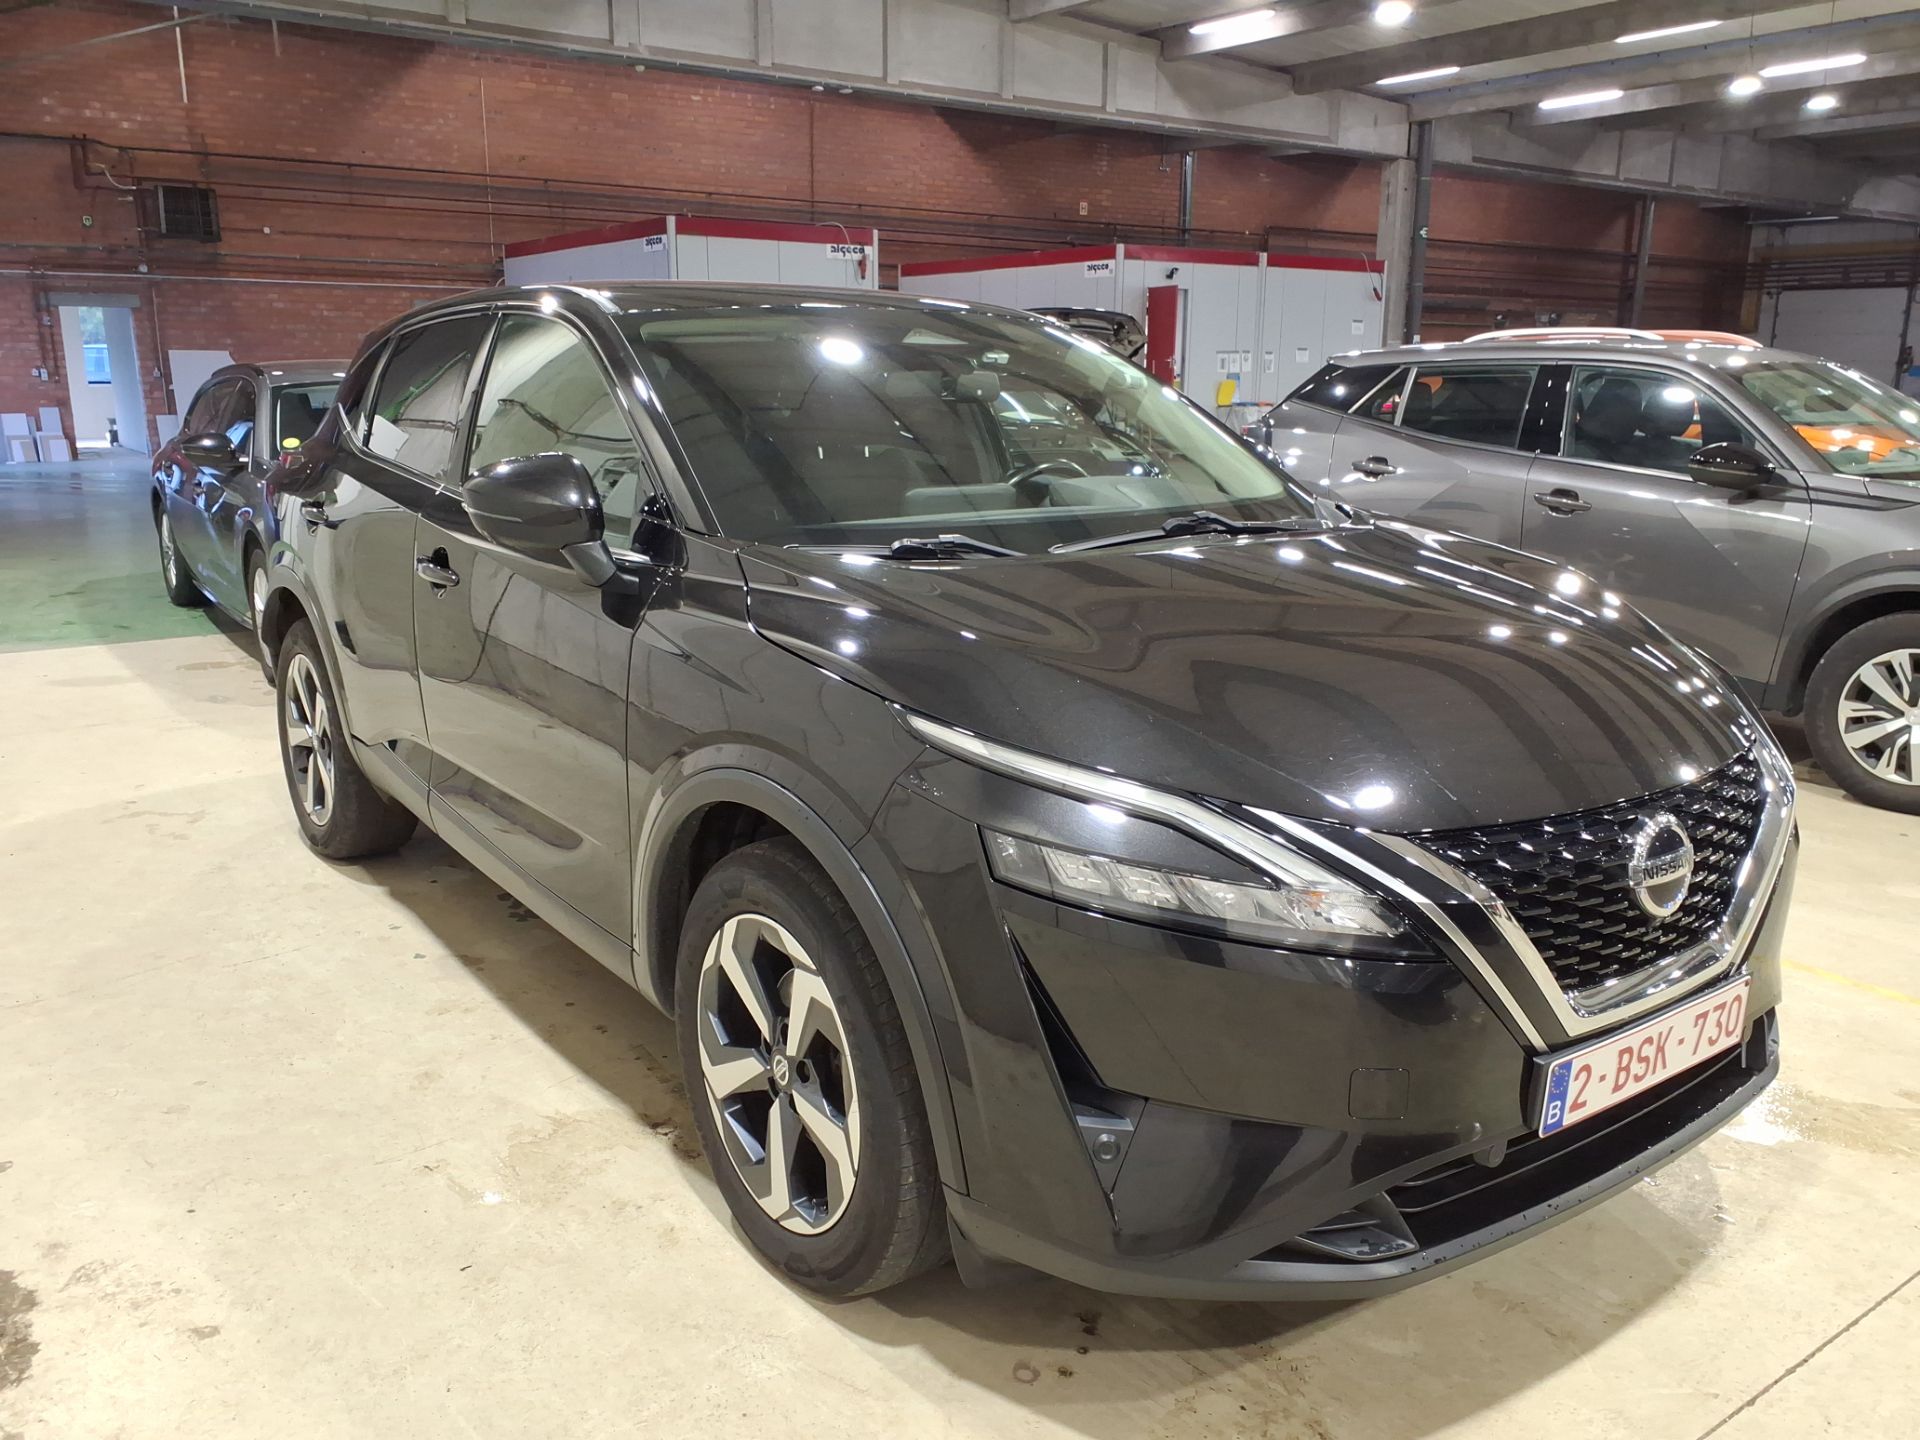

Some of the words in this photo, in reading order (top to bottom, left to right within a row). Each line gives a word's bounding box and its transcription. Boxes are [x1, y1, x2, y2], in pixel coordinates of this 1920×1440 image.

[1643, 856, 1690, 880] NISSAN
[1568, 994, 1743, 1114] 2-BSK-730
[1547, 1101, 1561, 1124] B
